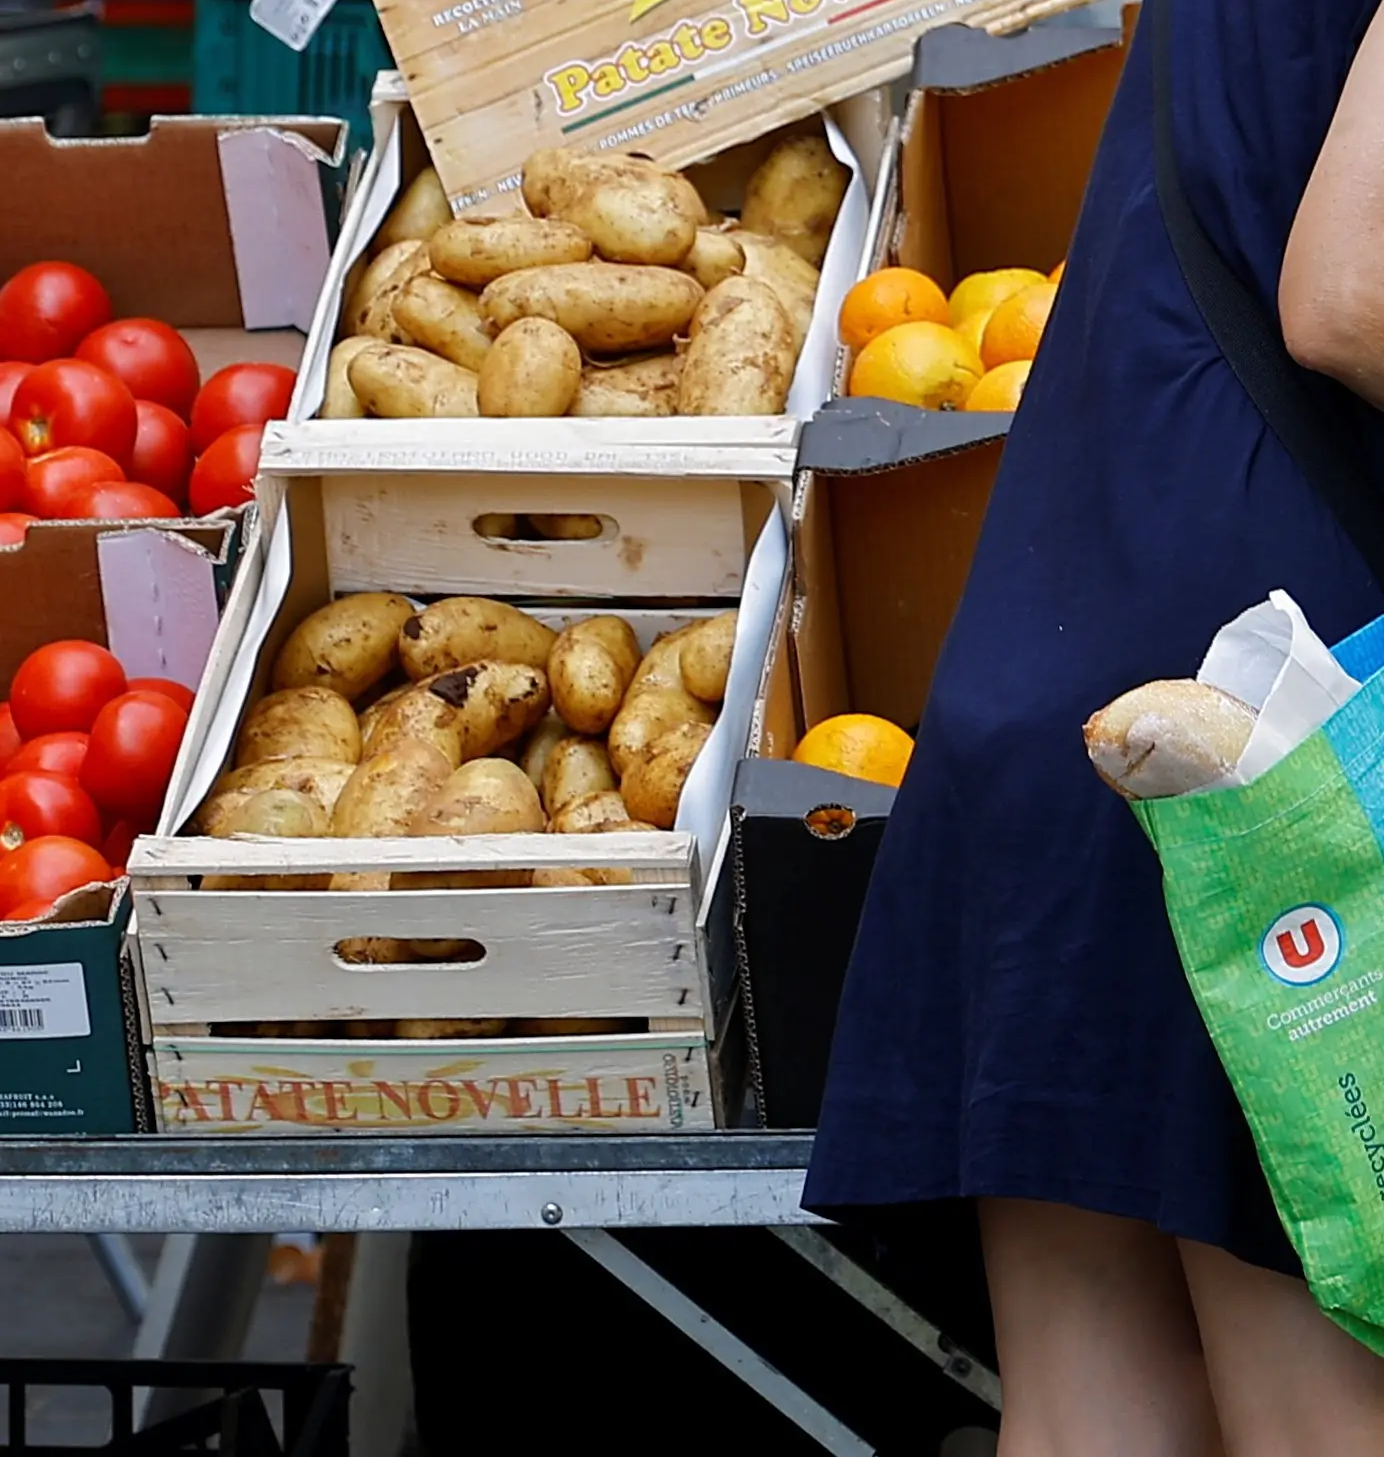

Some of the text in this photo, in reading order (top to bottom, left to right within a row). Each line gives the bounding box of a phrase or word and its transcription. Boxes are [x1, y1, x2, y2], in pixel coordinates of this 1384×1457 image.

[458, 0, 522, 34] LA MAIN
[552, 17, 731, 111] Patate
[599, 122, 653, 150] POMMES
[655, 114, 672, 129] DE
[1276, 918, 1325, 968] U
[1267, 969, 1384, 1030] Commerçants
[1288, 990, 1378, 1042] autrement
[375, 1077, 661, 1123] NOVELLE
